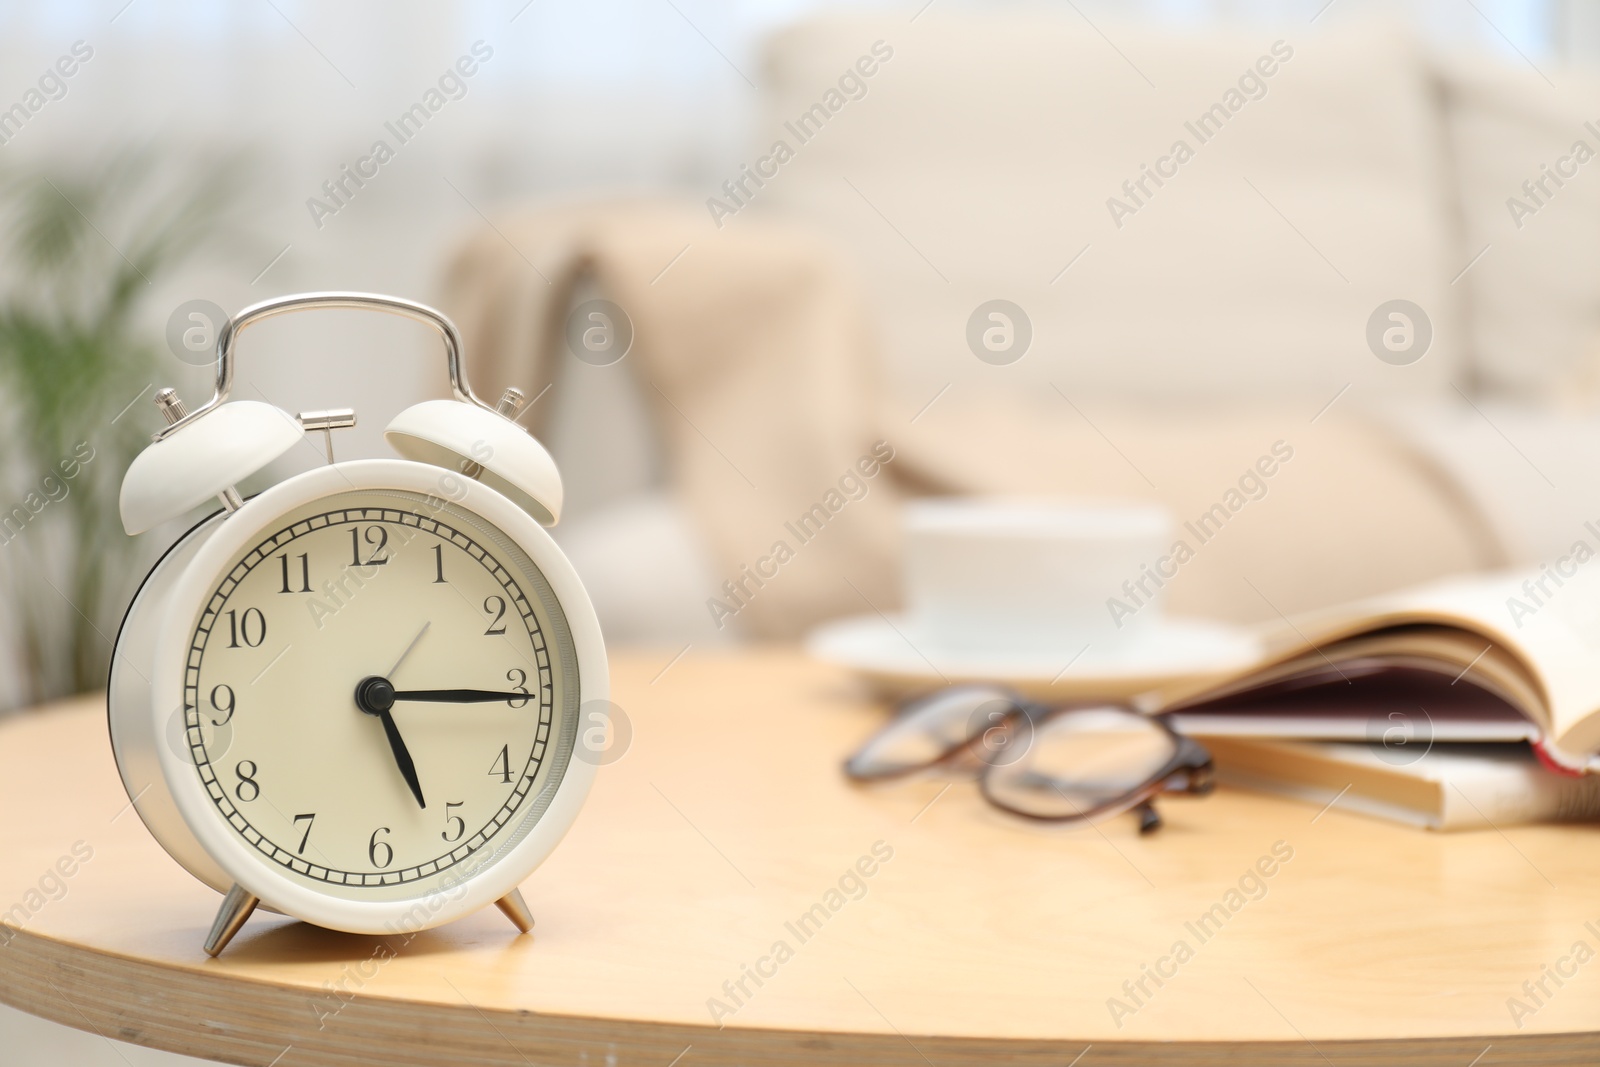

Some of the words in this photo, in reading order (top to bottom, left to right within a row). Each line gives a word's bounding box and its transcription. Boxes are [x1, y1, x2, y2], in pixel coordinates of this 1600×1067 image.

[348, 526, 388, 566] 12
[431, 544, 447, 583] 1
[276, 553, 313, 593] 11
[225, 608, 266, 648] 10
[484, 596, 506, 635] 2
[210, 685, 235, 726] 9
[505, 669, 530, 709] 3
[235, 760, 260, 802] 8
[488, 744, 514, 783] 4
[293, 813, 315, 854] 7
[442, 801, 465, 841] 5
[369, 827, 393, 868] 6
